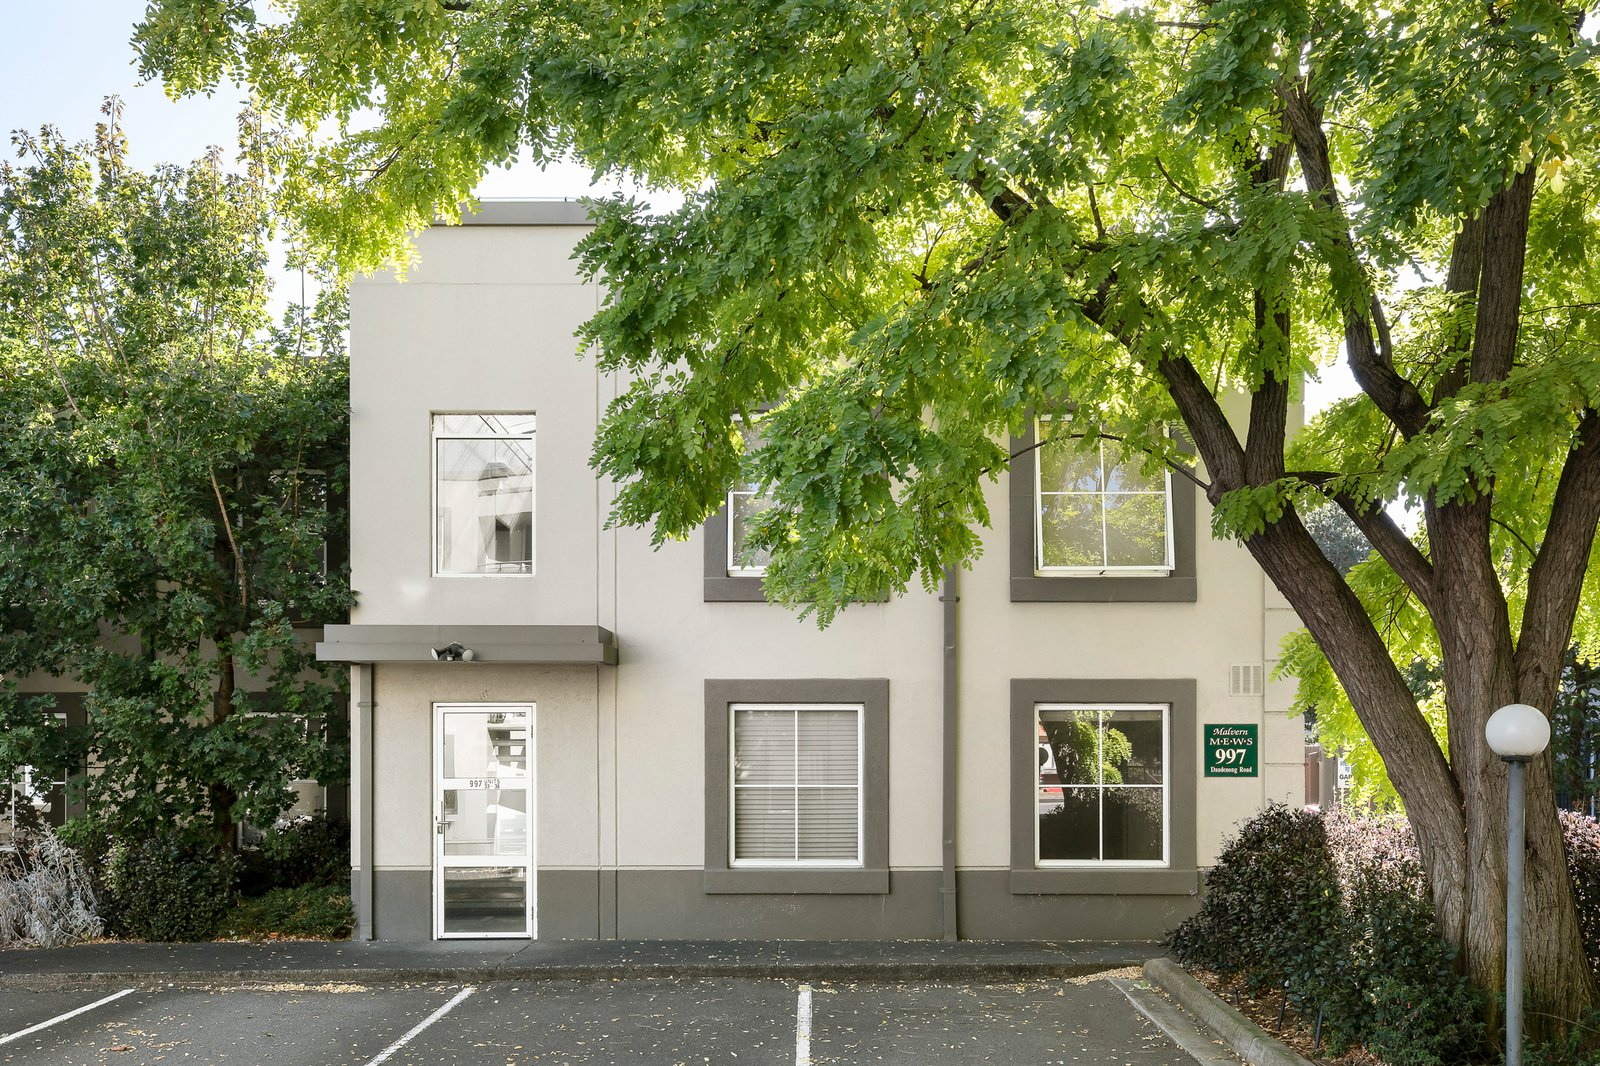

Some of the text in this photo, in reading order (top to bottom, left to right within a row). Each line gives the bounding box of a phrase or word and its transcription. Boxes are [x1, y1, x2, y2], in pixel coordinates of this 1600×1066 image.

[1213, 727, 1248, 736] Malvern
[1215, 748, 1246, 765] 997
[1210, 766, 1238, 774] Dandenong
